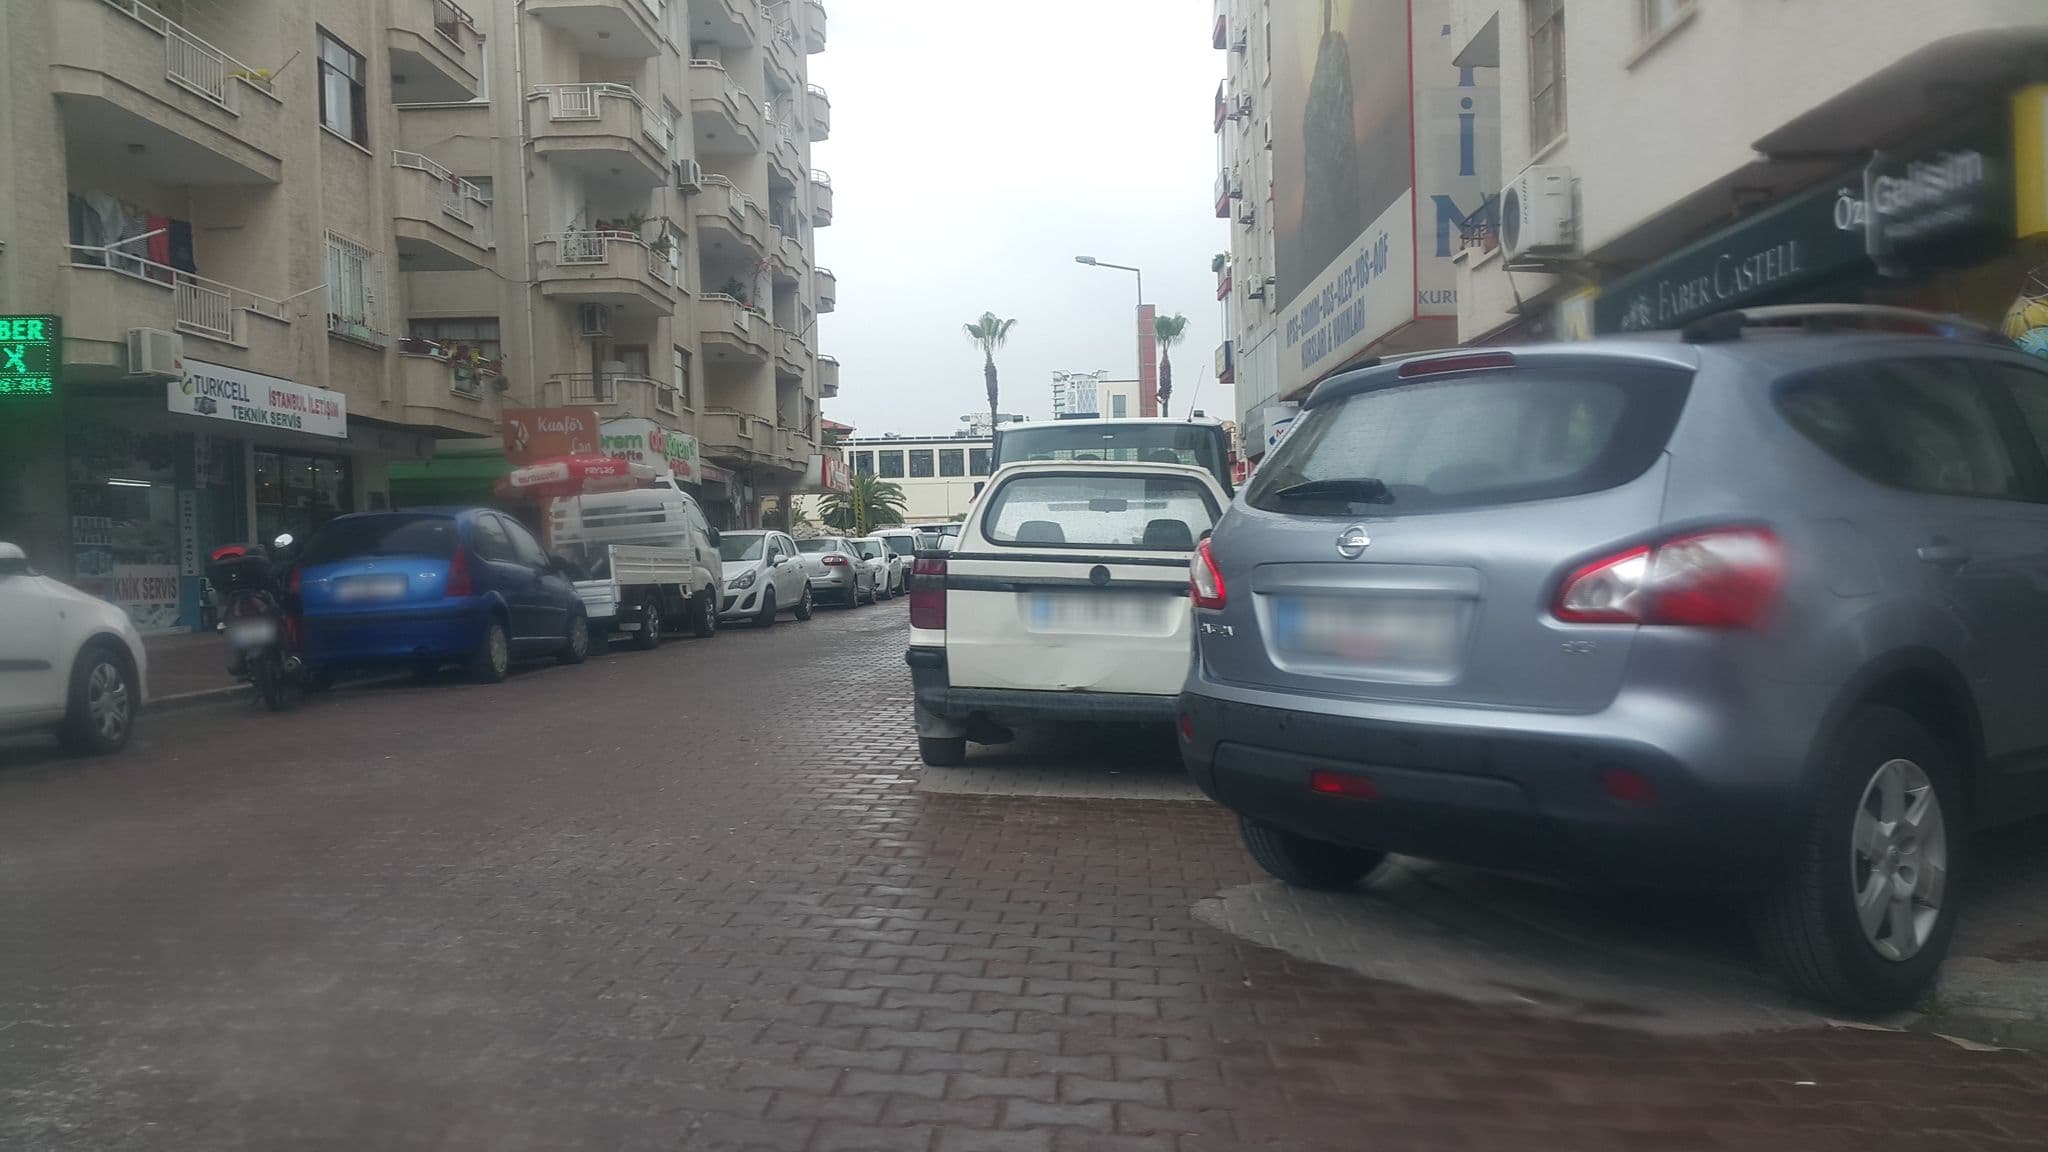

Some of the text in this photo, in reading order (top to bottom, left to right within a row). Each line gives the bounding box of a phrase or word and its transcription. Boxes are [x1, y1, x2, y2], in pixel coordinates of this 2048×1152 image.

[193, 374, 250, 402] TURKCELL
[268, 385, 339, 420] İSTANBUL İLETİŞİM
[232, 405, 302, 429] TEKNİK SERVİS
